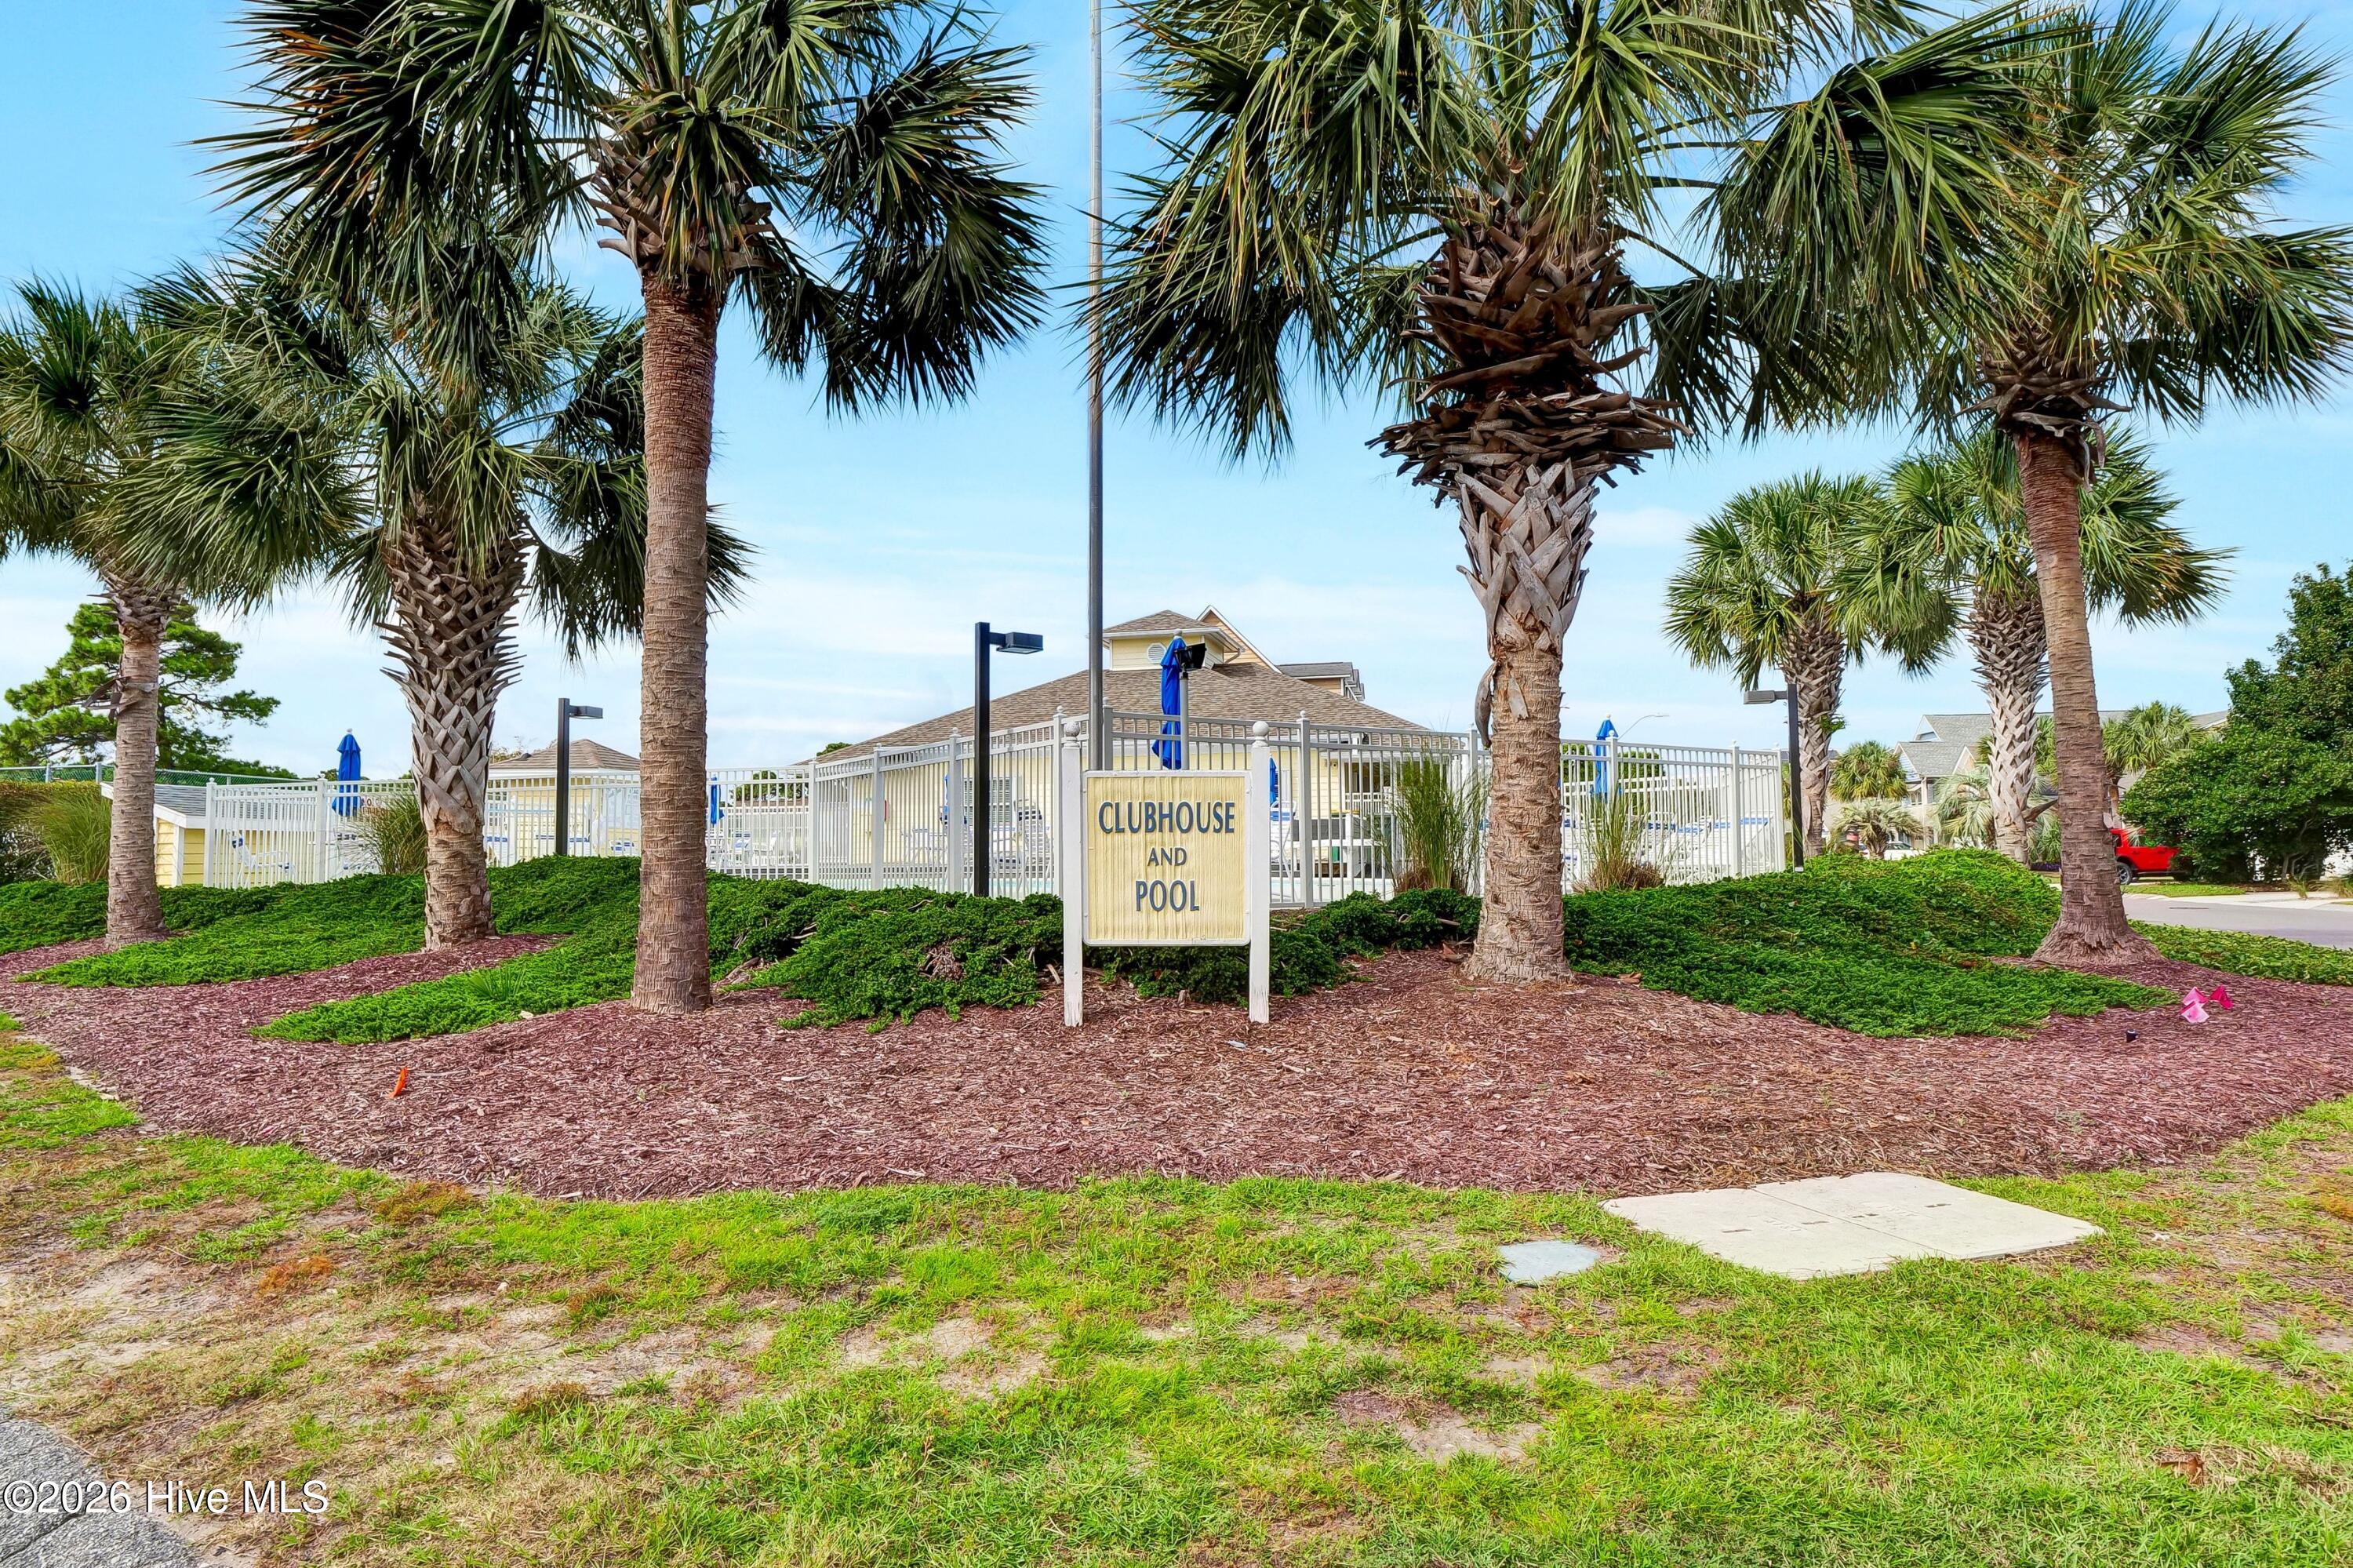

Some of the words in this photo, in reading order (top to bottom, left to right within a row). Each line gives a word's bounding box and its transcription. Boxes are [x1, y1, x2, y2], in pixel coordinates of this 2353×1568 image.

[1099, 801, 1235, 834] CLUBHOUSE
[1147, 847, 1187, 867] AND
[1136, 880, 1200, 912] POOL
